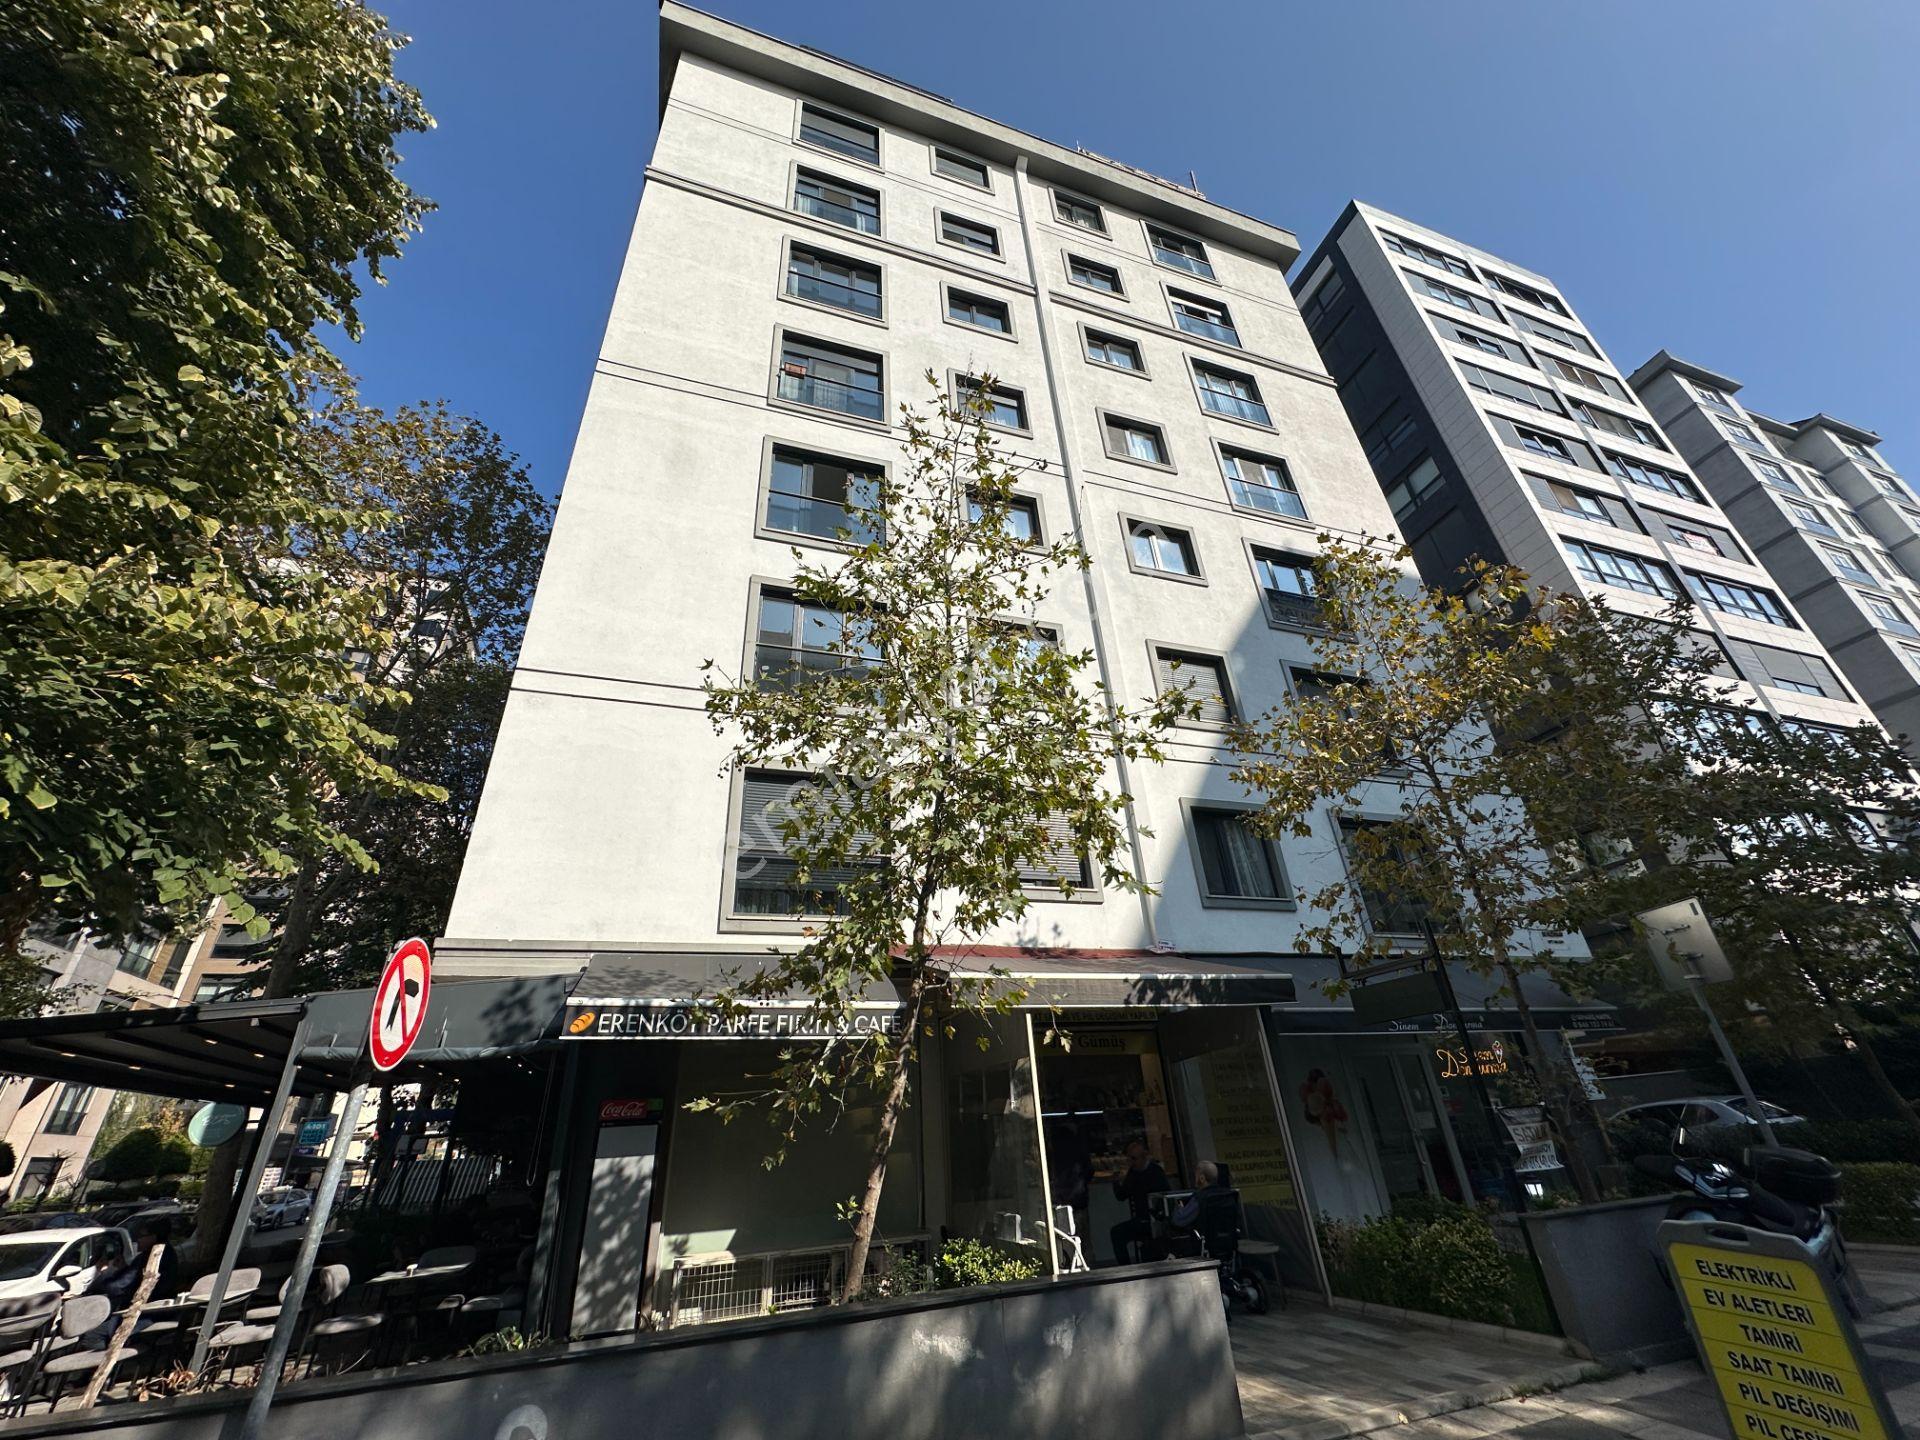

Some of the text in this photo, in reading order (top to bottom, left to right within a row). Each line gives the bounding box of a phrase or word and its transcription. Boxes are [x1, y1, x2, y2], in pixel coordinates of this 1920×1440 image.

[854, 1015, 901, 1034] CAFE
[1695, 1259, 1797, 1291] ELEKTRİKLİ
[1703, 1288, 1816, 1326] EV ALETLERİ
[1739, 1323, 1804, 1354] TAMİRİ
[1727, 1351, 1845, 1396] SAAT TAMİRİ
[1738, 1381, 1771, 1407] PİL
[1745, 1413, 1778, 1439] PİL
